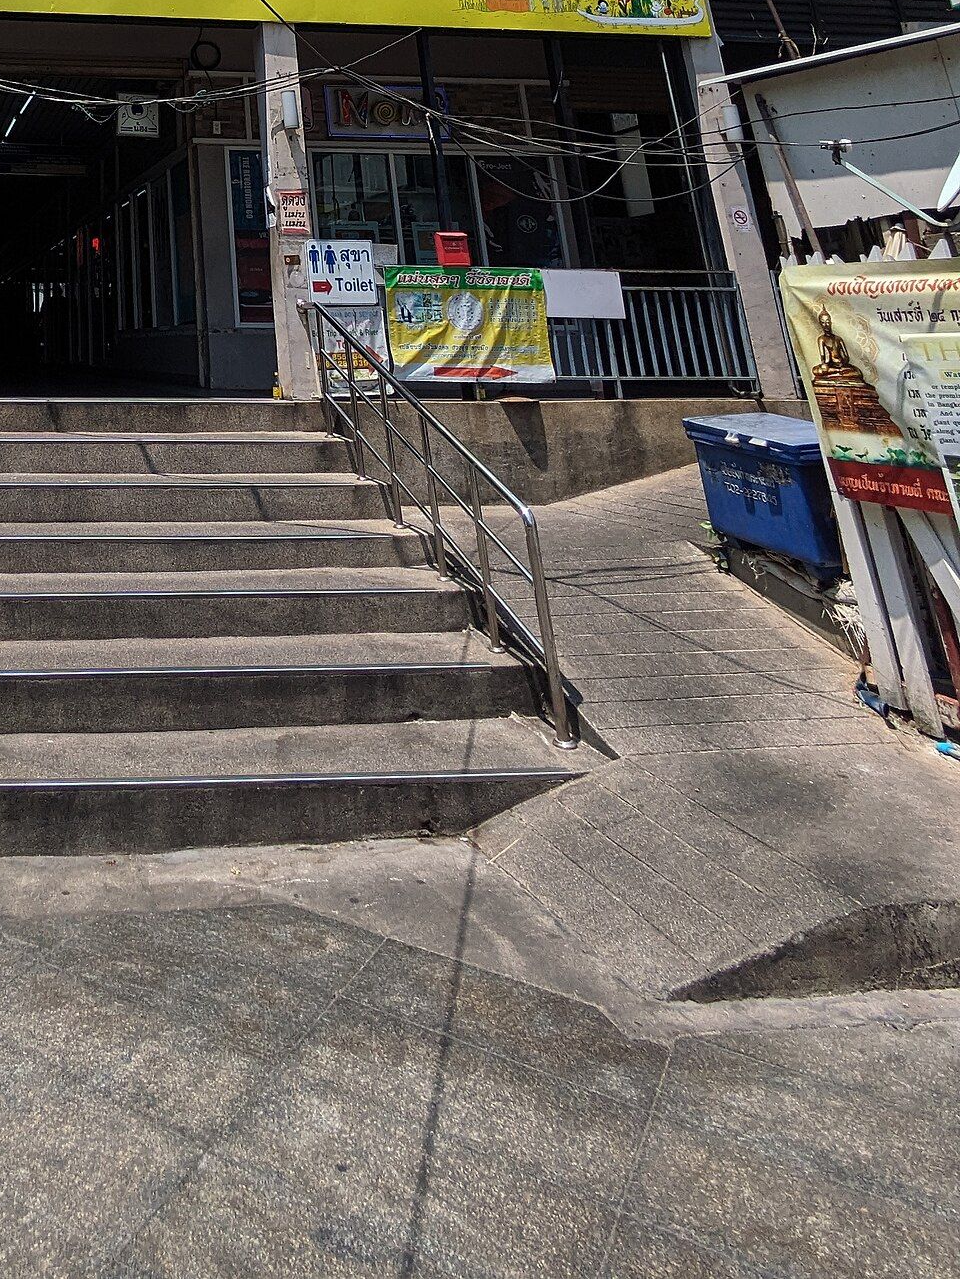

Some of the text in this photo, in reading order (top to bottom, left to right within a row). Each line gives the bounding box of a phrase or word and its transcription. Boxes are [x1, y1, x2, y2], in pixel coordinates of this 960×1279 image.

[281, 195, 306, 211] ดูดวง
[284, 209, 305, 218] แม่น
[285, 218, 306, 227] แม่น
[340, 248, 370, 269] สุขา
[335, 277, 374, 293] Toilet
